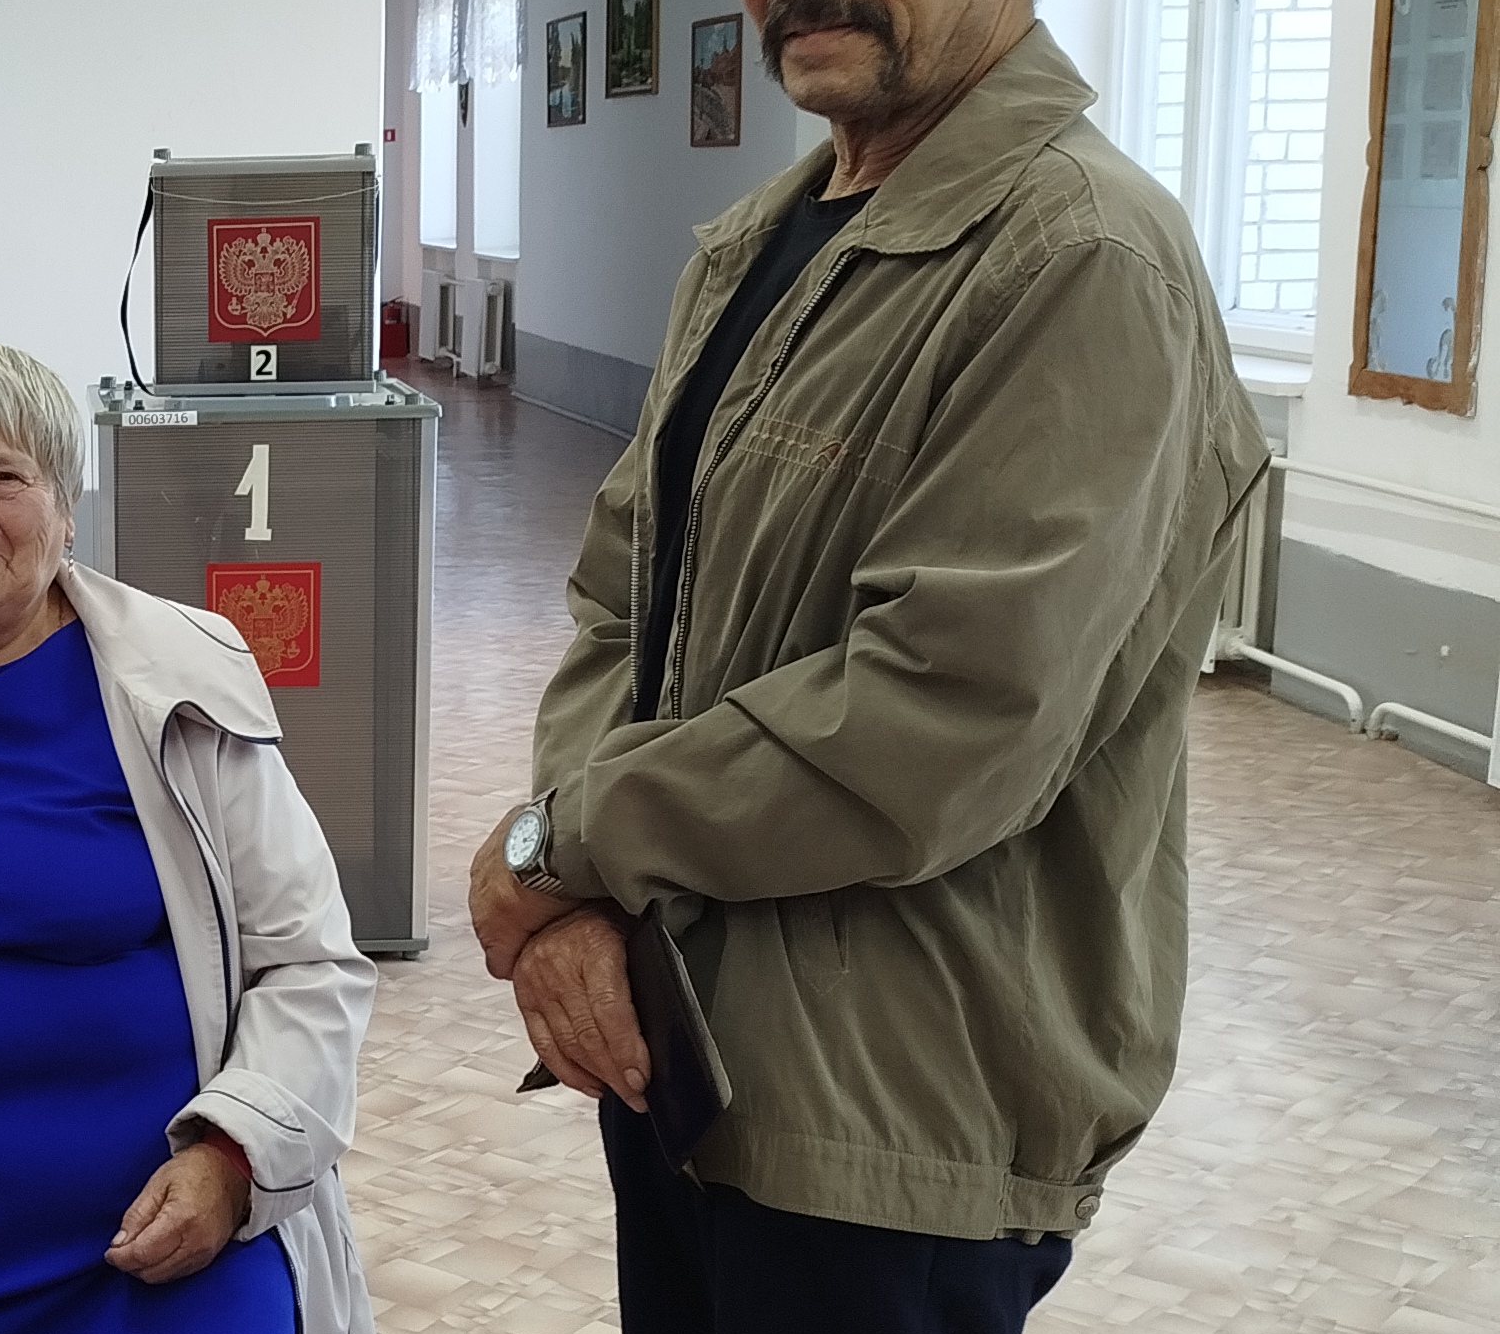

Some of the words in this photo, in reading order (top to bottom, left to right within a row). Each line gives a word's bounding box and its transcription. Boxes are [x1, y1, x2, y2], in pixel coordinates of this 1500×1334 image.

[255, 349, 273, 376] 2
[128, 413, 189, 425] 00603716
[233, 444, 273, 541] 1
